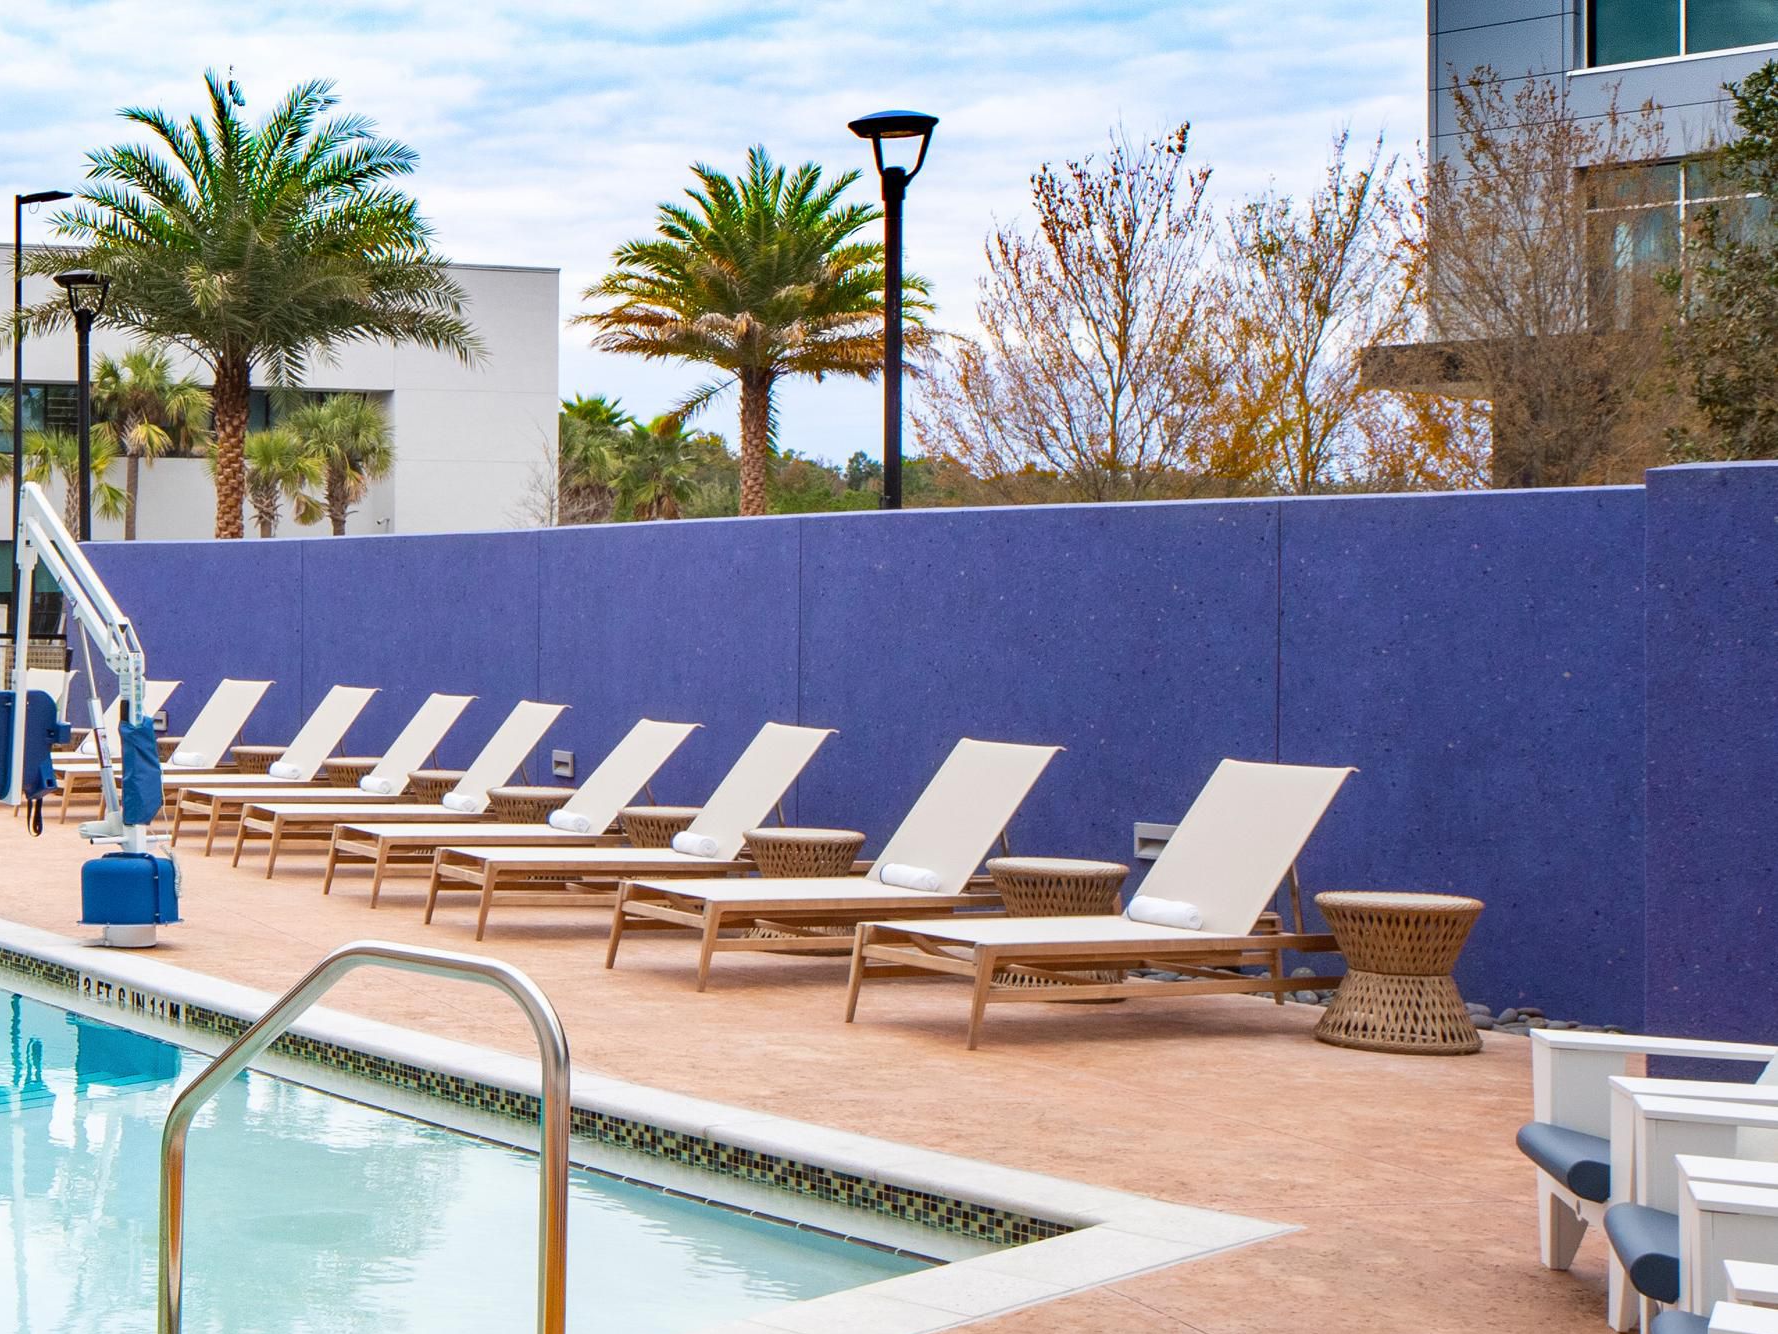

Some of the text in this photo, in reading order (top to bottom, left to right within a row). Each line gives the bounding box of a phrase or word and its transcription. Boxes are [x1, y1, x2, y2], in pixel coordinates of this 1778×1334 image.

[97, 980, 112, 998] FT
[131, 990, 145, 1009] IN
[169, 1002, 181, 1020] M
